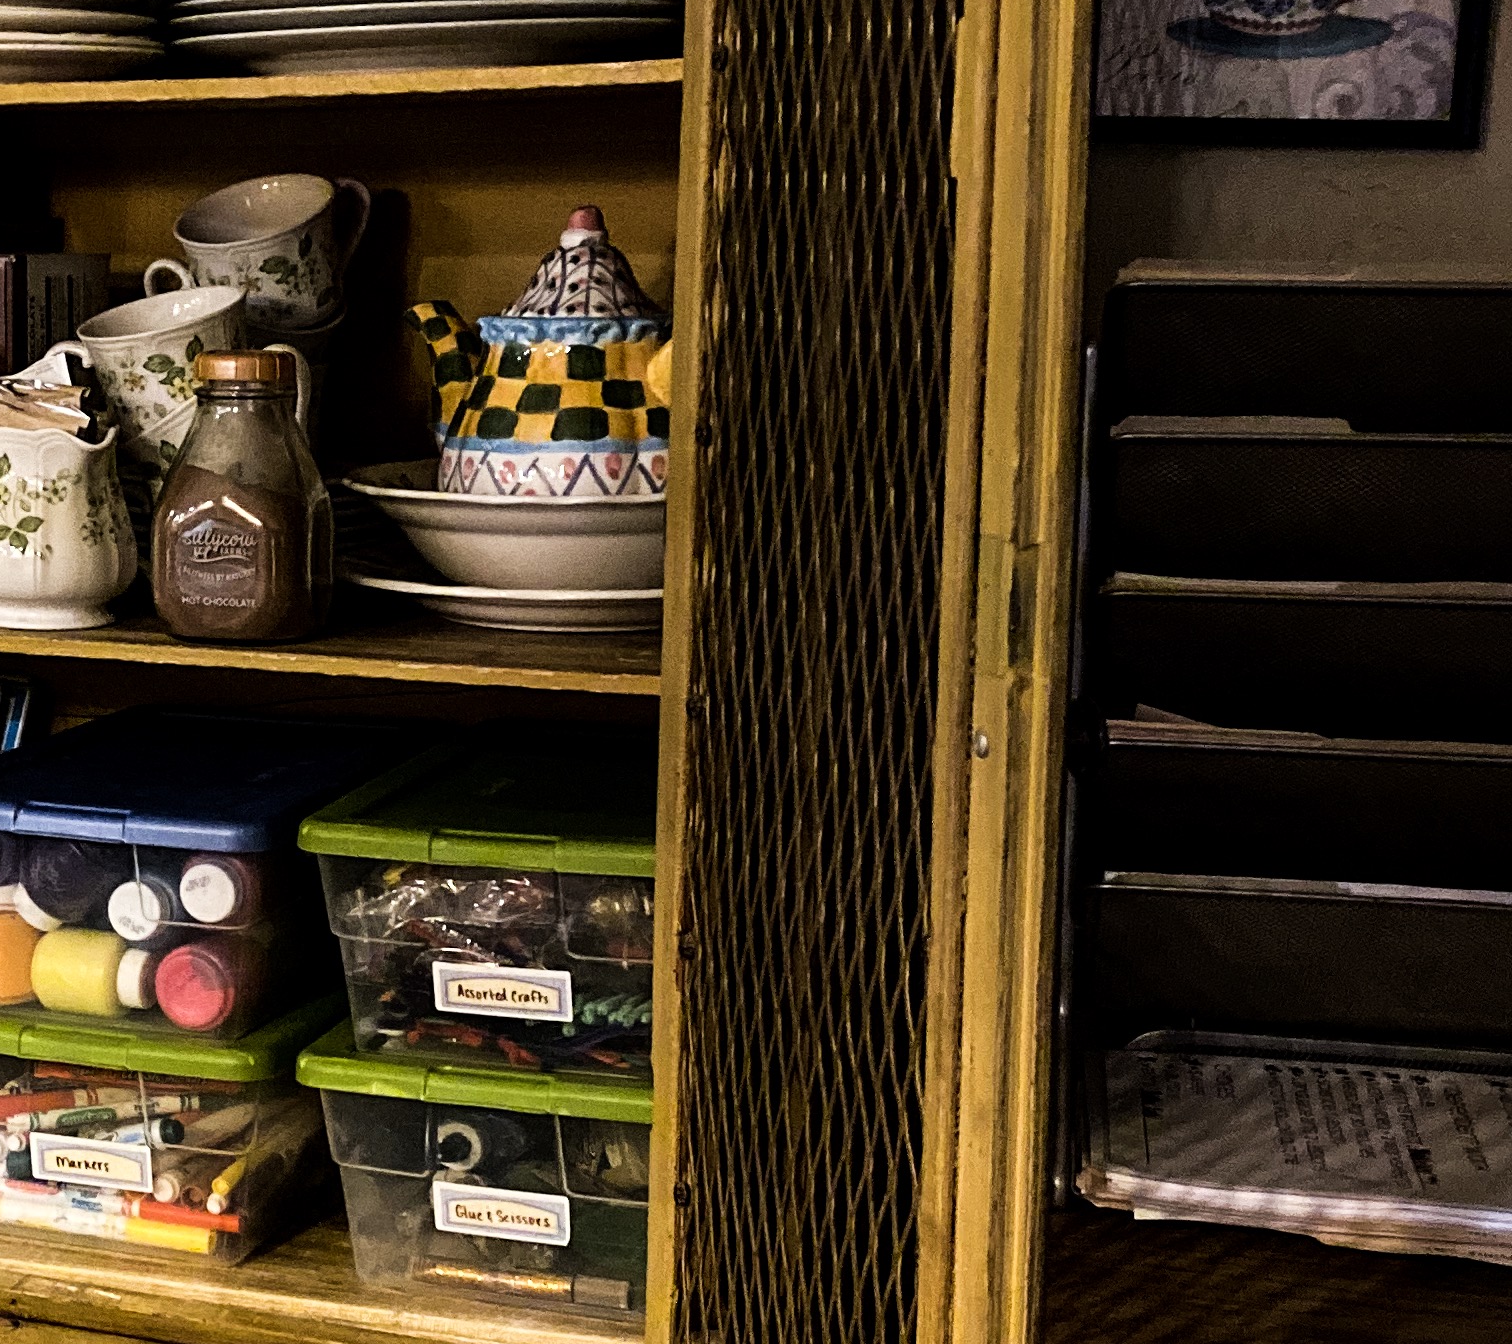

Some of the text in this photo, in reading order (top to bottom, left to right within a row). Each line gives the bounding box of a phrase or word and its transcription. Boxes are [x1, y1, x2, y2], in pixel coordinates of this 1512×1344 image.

[181, 596, 256, 608] HOT CHOCOLATE
[457, 984, 549, 1004] Assorted Crafts
[56, 1155, 110, 1173] Markers
[455, 1203, 483, 1222] Glue
[495, 1209, 551, 1228] Scissors
